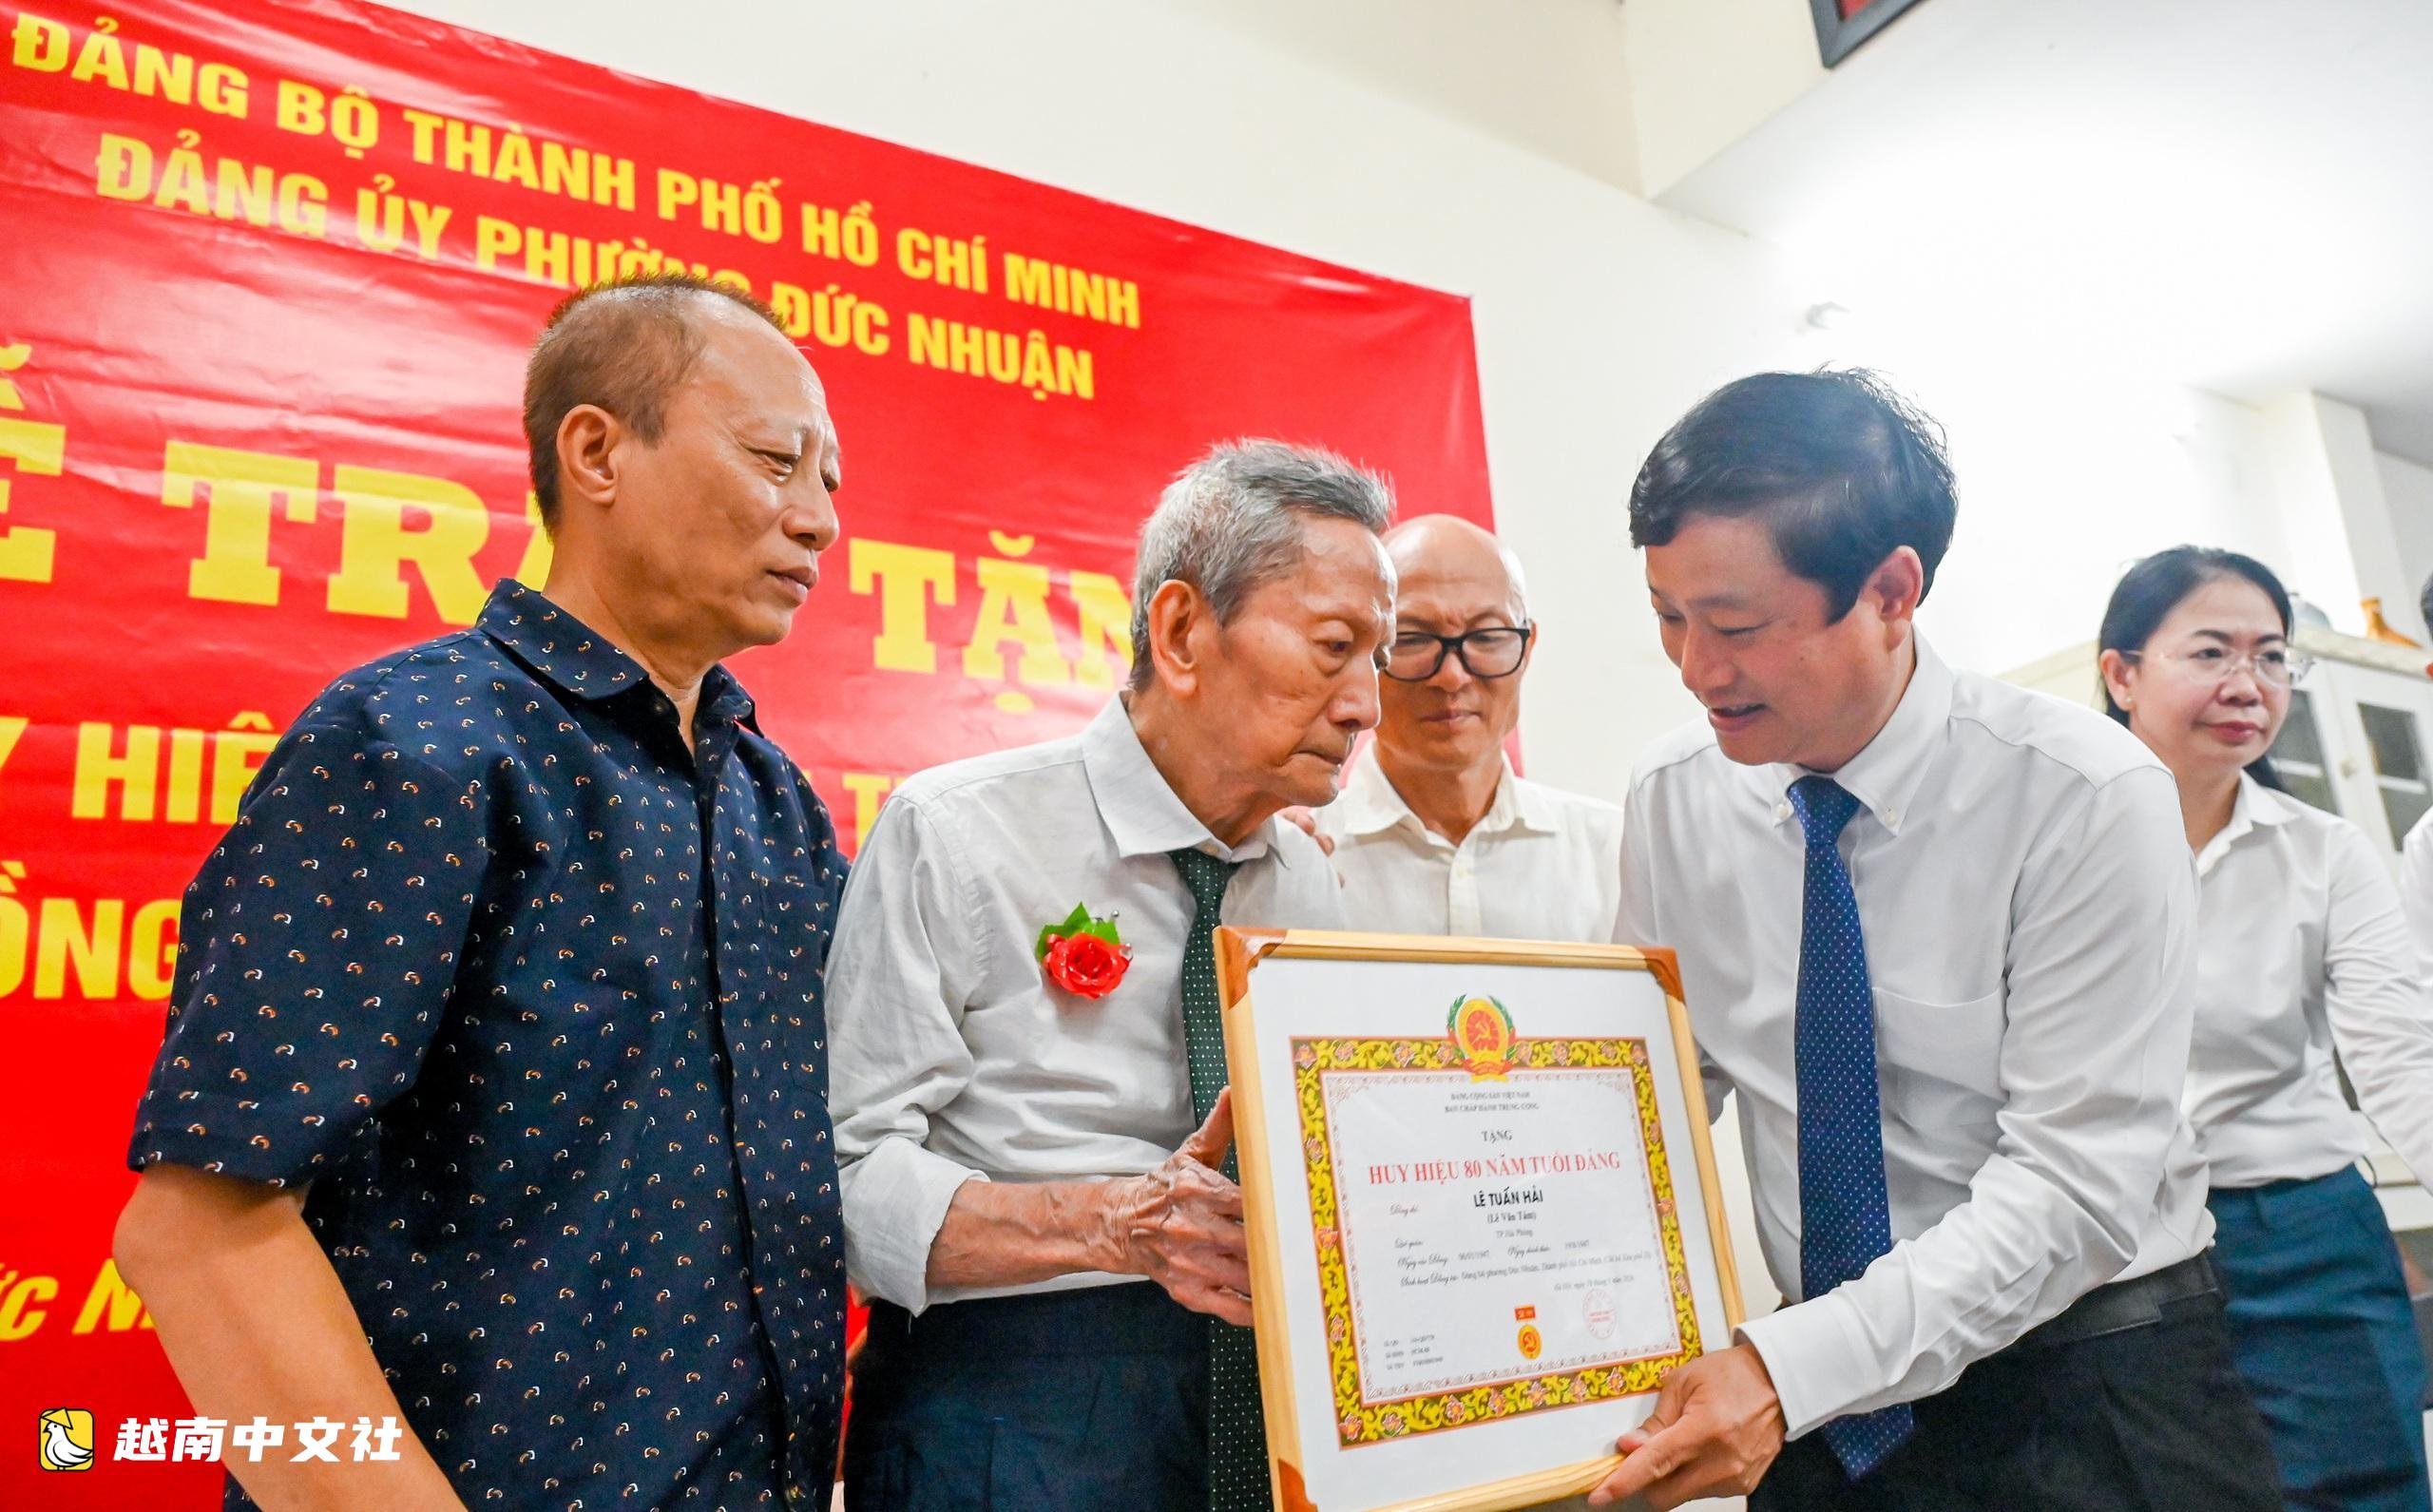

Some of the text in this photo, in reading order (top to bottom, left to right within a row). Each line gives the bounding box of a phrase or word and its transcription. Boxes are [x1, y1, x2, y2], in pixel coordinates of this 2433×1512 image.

[11, 13, 1140, 329] ĐẢNG BỘ THÀNH PHỐ HỒ CHÍ MINH
[96, 129, 328, 238] ĐẢNG
[356, 174, 452, 260] ỦY
[770, 282, 890, 355] ĐỨC
[908, 312, 1094, 400] NHUẬN
[1369, 1162, 1409, 1186] HUY
[1414, 1158, 1459, 1185] HIỆU
[1463, 1158, 1483, 1178] 80
[1574, 1148, 1620, 1172] ĐẢNG
[1523, 1185, 1543, 1204] HẢI
